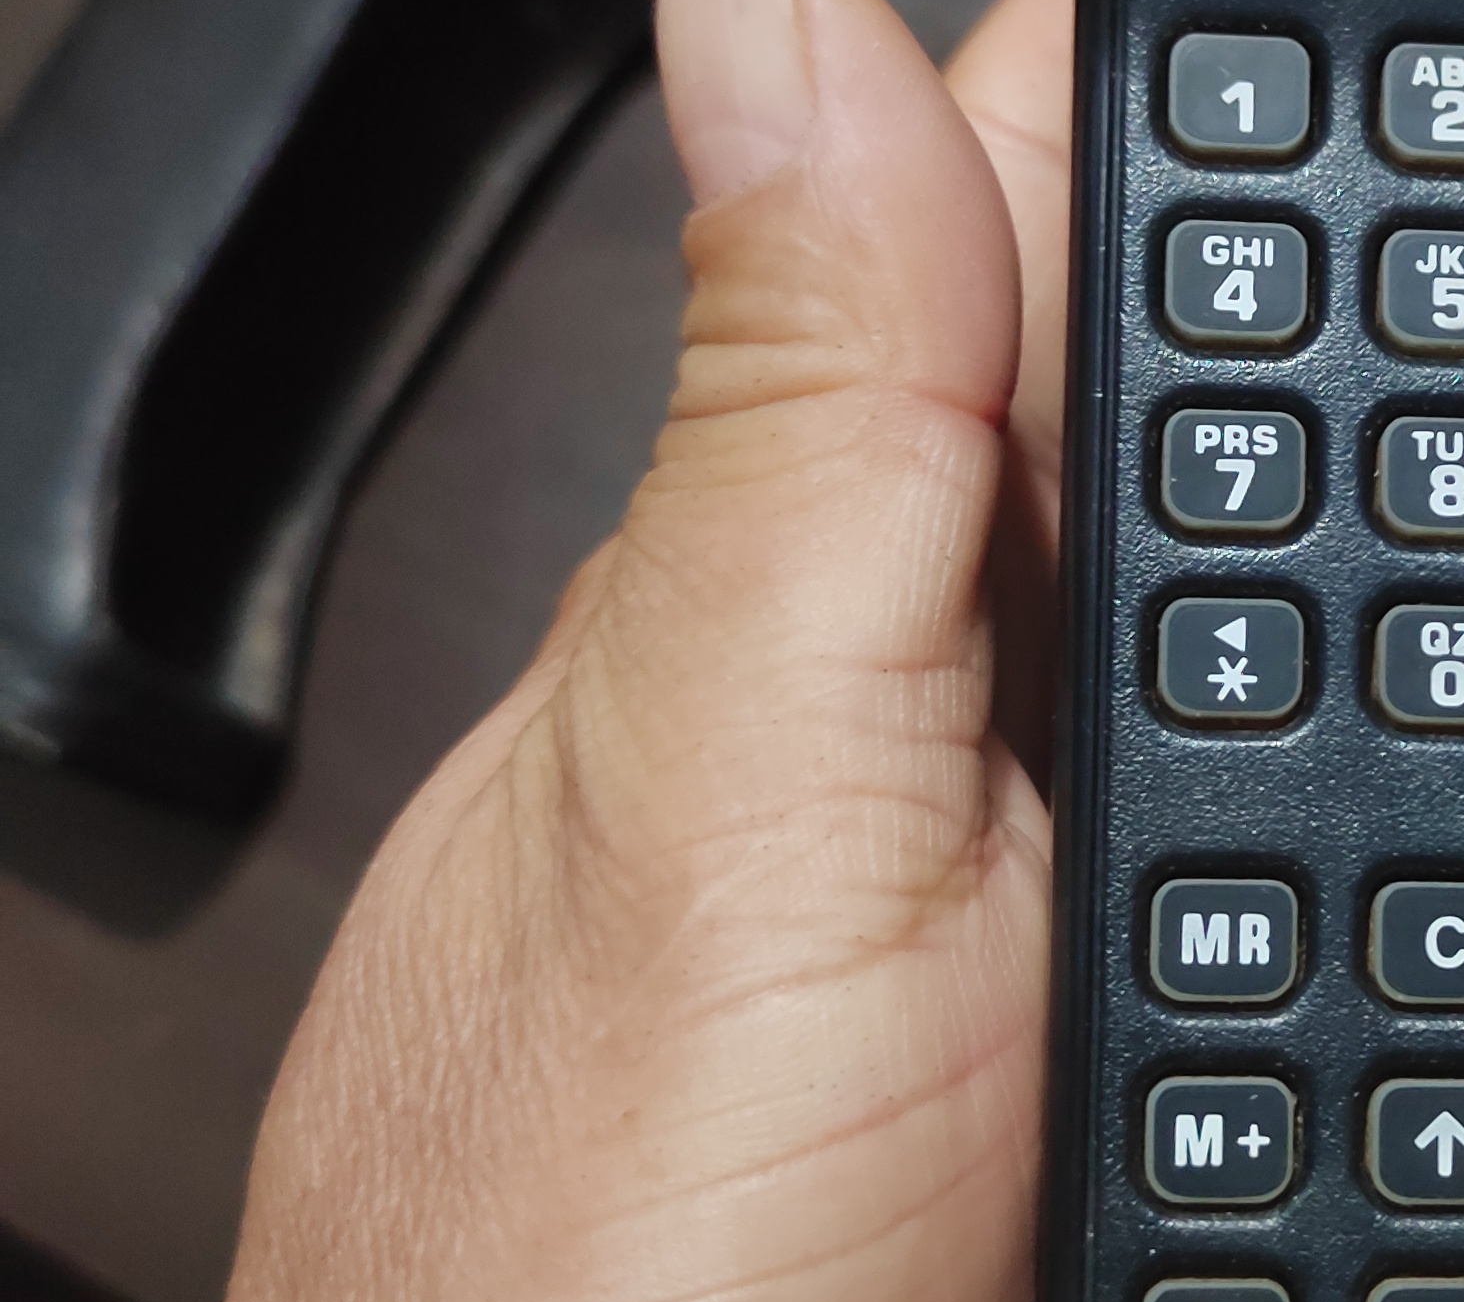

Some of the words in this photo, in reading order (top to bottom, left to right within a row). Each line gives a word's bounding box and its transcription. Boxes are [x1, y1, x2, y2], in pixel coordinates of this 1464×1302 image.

[1220, 80, 1255, 133] 1
[1202, 235, 1275, 268] GHI
[1212, 269, 1258, 322] 4
[1194, 424, 1279, 456] PRS
[1215, 458, 1256, 511] 7
[1181, 912, 1271, 965] MR
